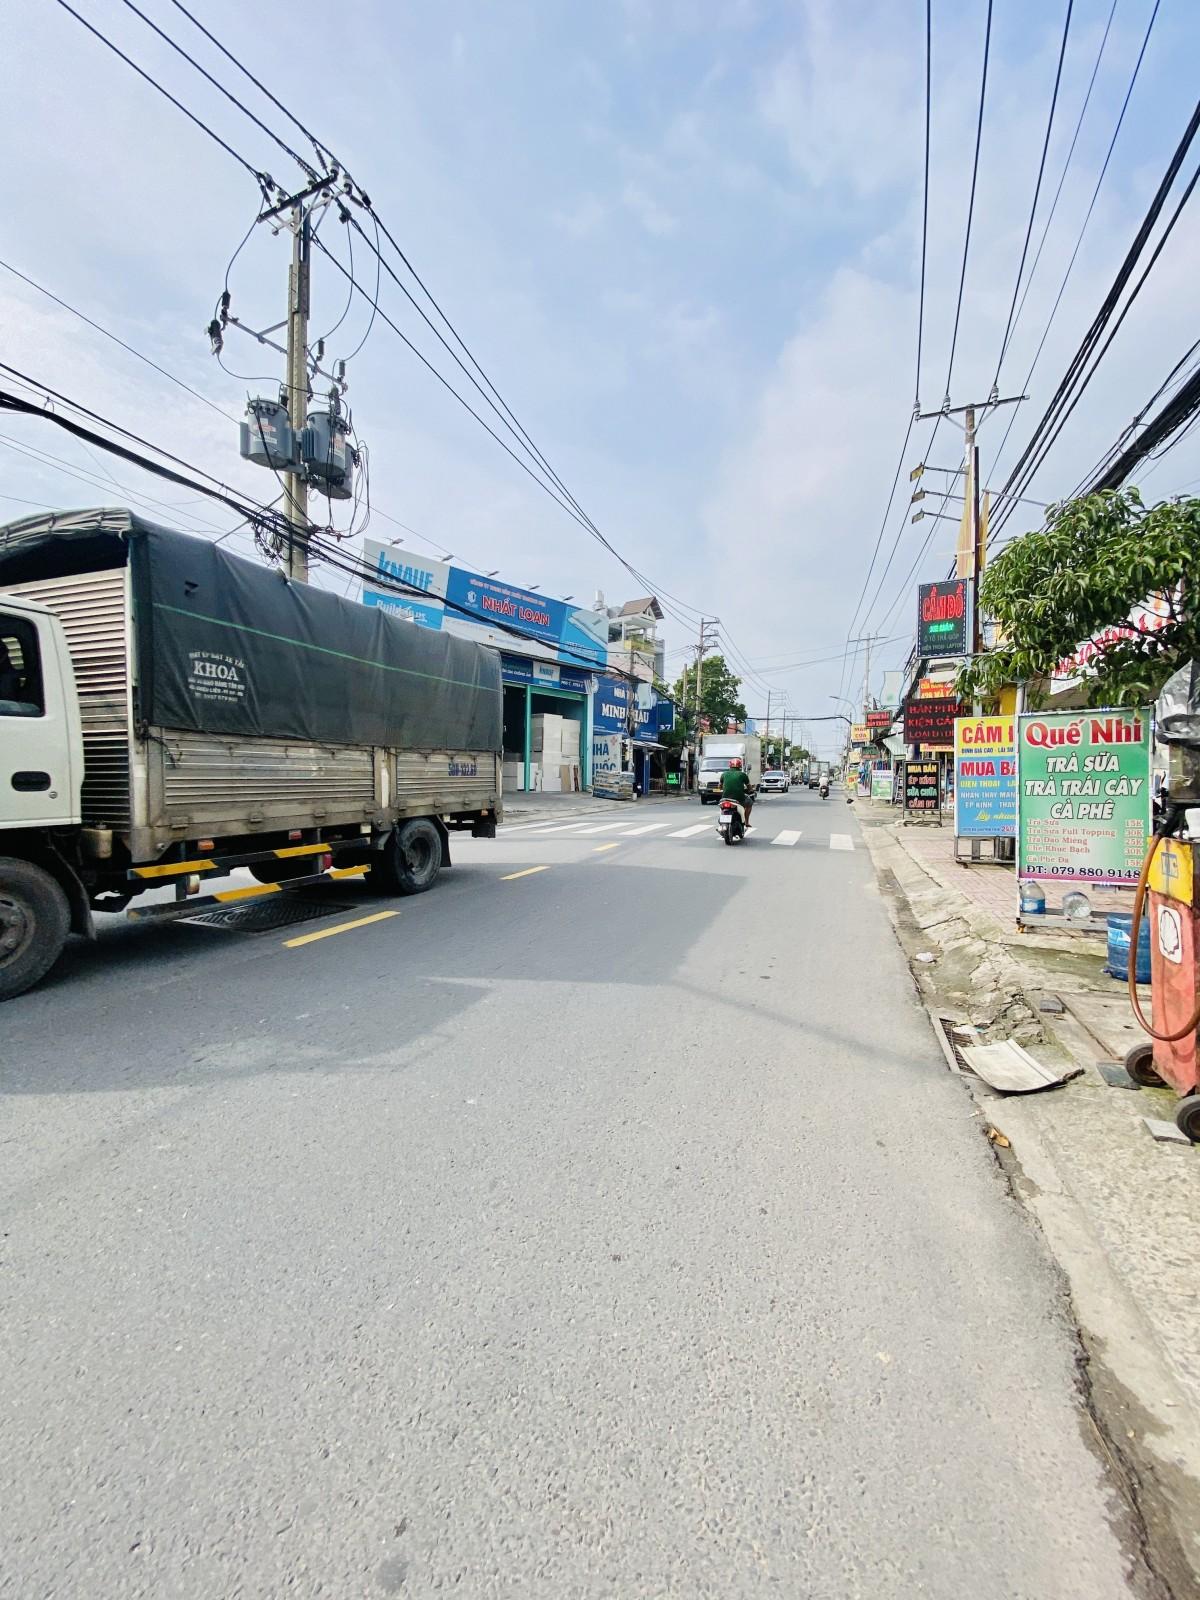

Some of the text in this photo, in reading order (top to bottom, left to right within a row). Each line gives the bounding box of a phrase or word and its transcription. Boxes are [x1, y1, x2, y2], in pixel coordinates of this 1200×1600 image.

[482, 594, 518, 617] NHẤT
[518, 605, 550, 627] LOAN
[193, 660, 239, 681] KHOA
[602, 703, 625, 719] MINH
[962, 721, 1002, 744] CẦM
[1026, 719, 1084, 748] Quế
[1091, 717, 1142, 744] Nhi
[961, 761, 995, 776] MUA
[1046, 750, 1120, 773] TRÀ SỮA
[1025, 775, 1143, 796] TRÀ TRÁI CÂY
[1051, 798, 1116, 820] CÀ PHÊ
[1062, 828, 1079, 836] Full
[1082, 829, 1116, 838] Topping
[1027, 865, 1141, 879] ĐT: 079 880 9148
